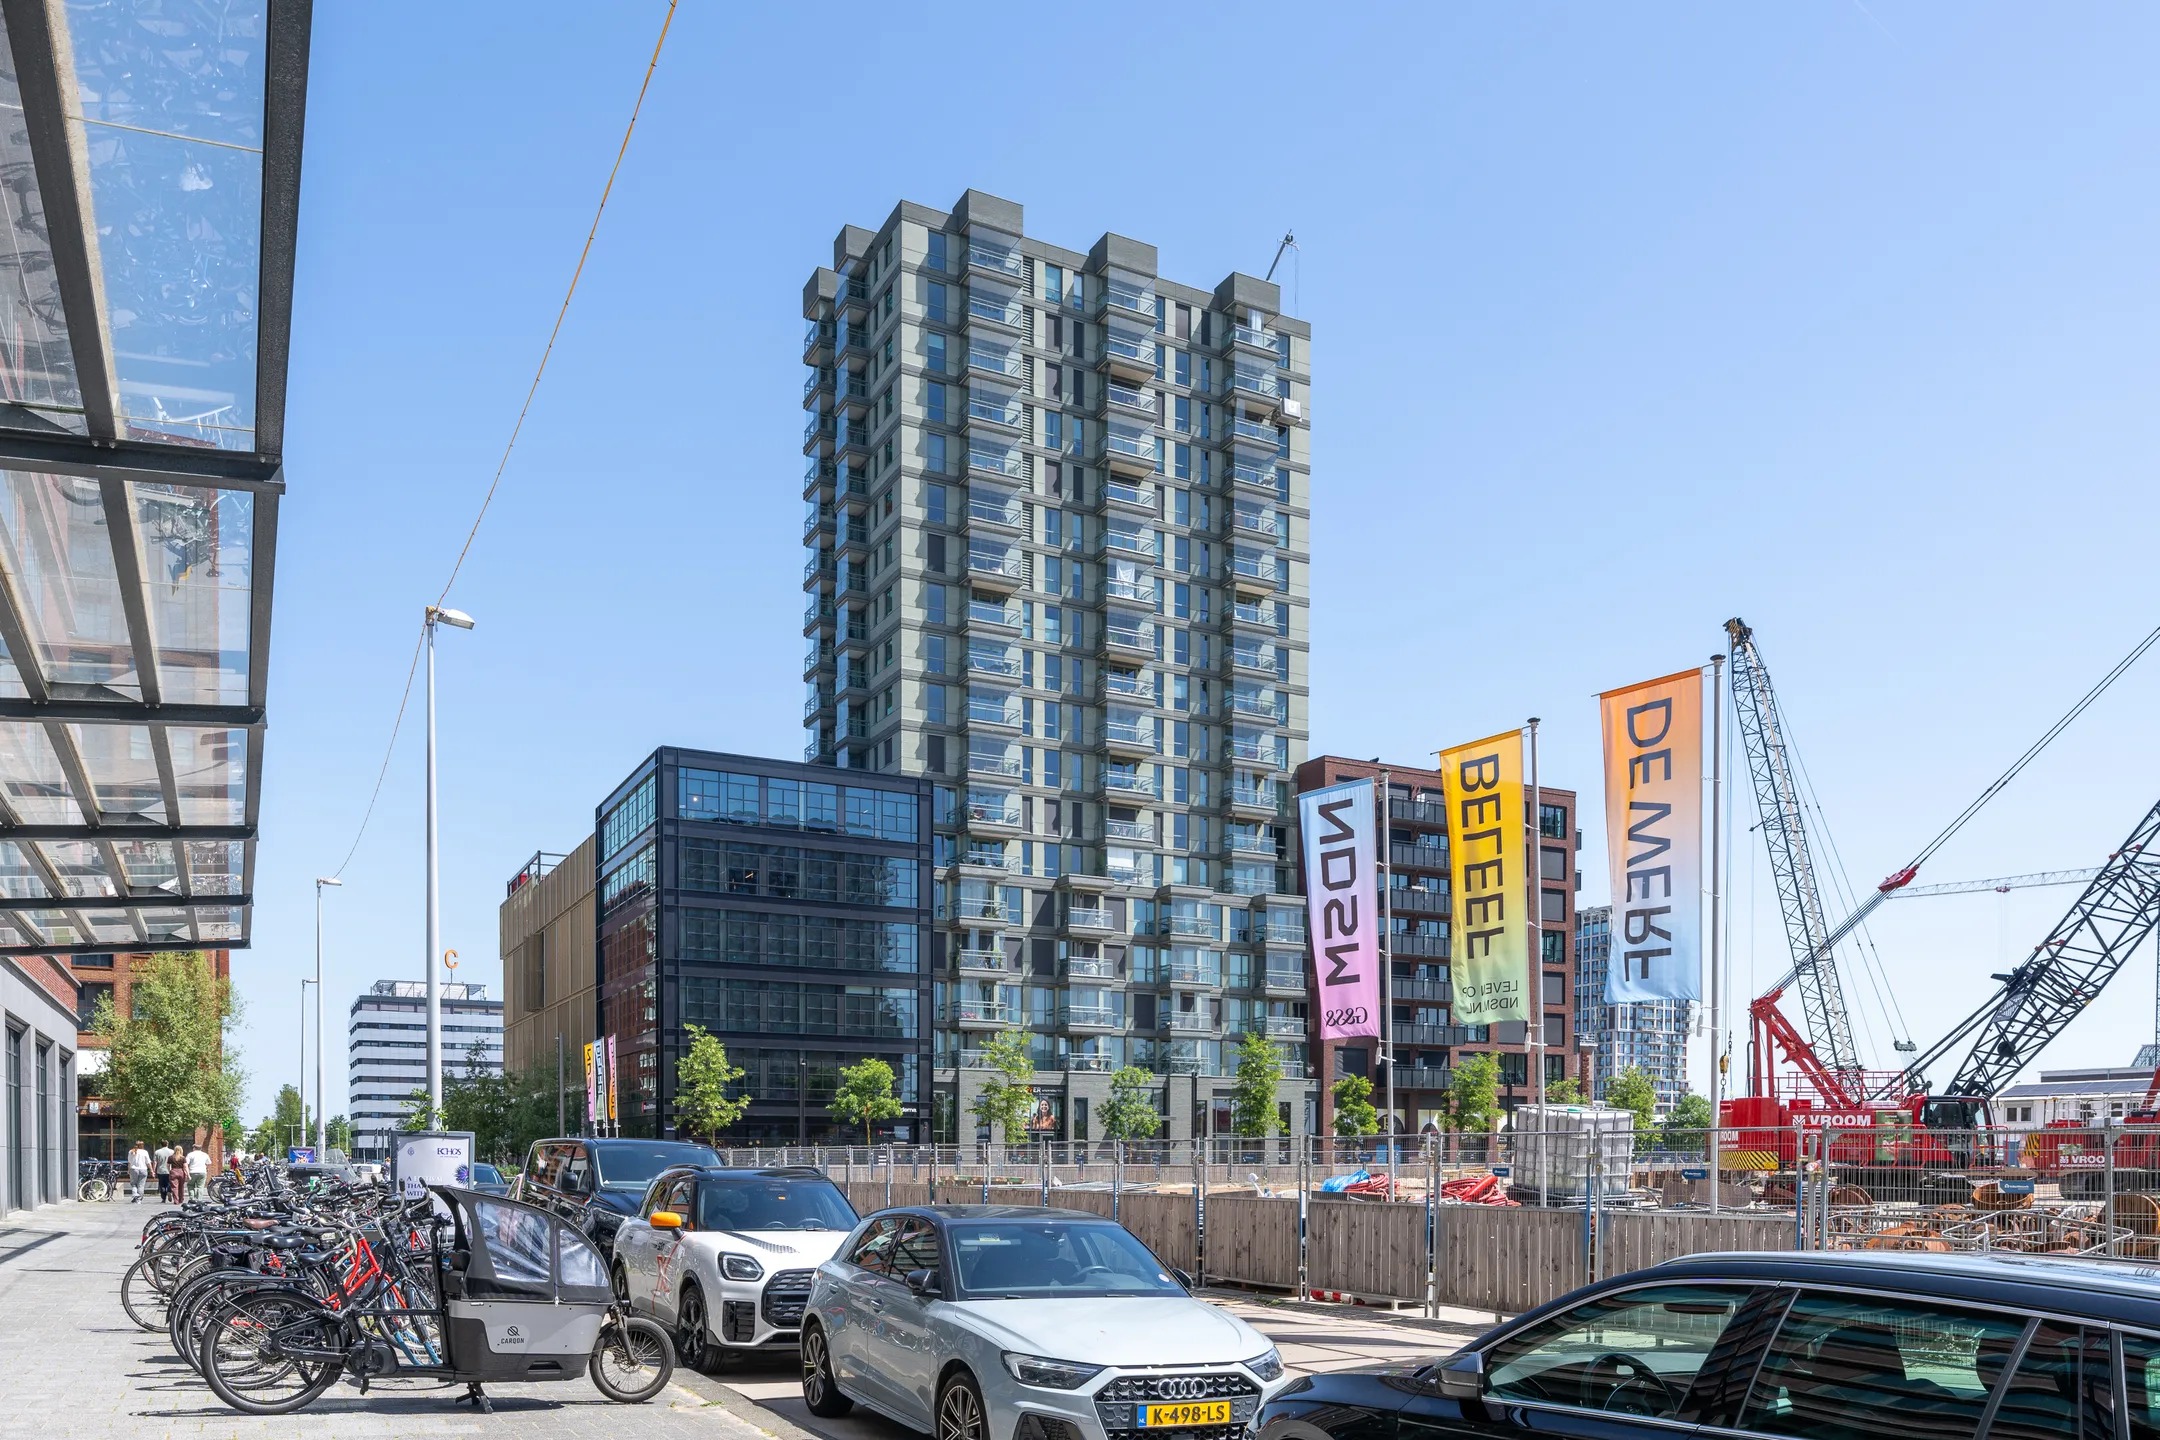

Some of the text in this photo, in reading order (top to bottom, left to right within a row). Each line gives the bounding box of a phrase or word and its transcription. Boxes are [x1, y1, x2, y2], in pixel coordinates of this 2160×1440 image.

[1808, 1115, 1871, 1129] VROOM
[500, 1337, 525, 1345] CARQON
[1152, 1404, 1225, 1426] K-498-LS
